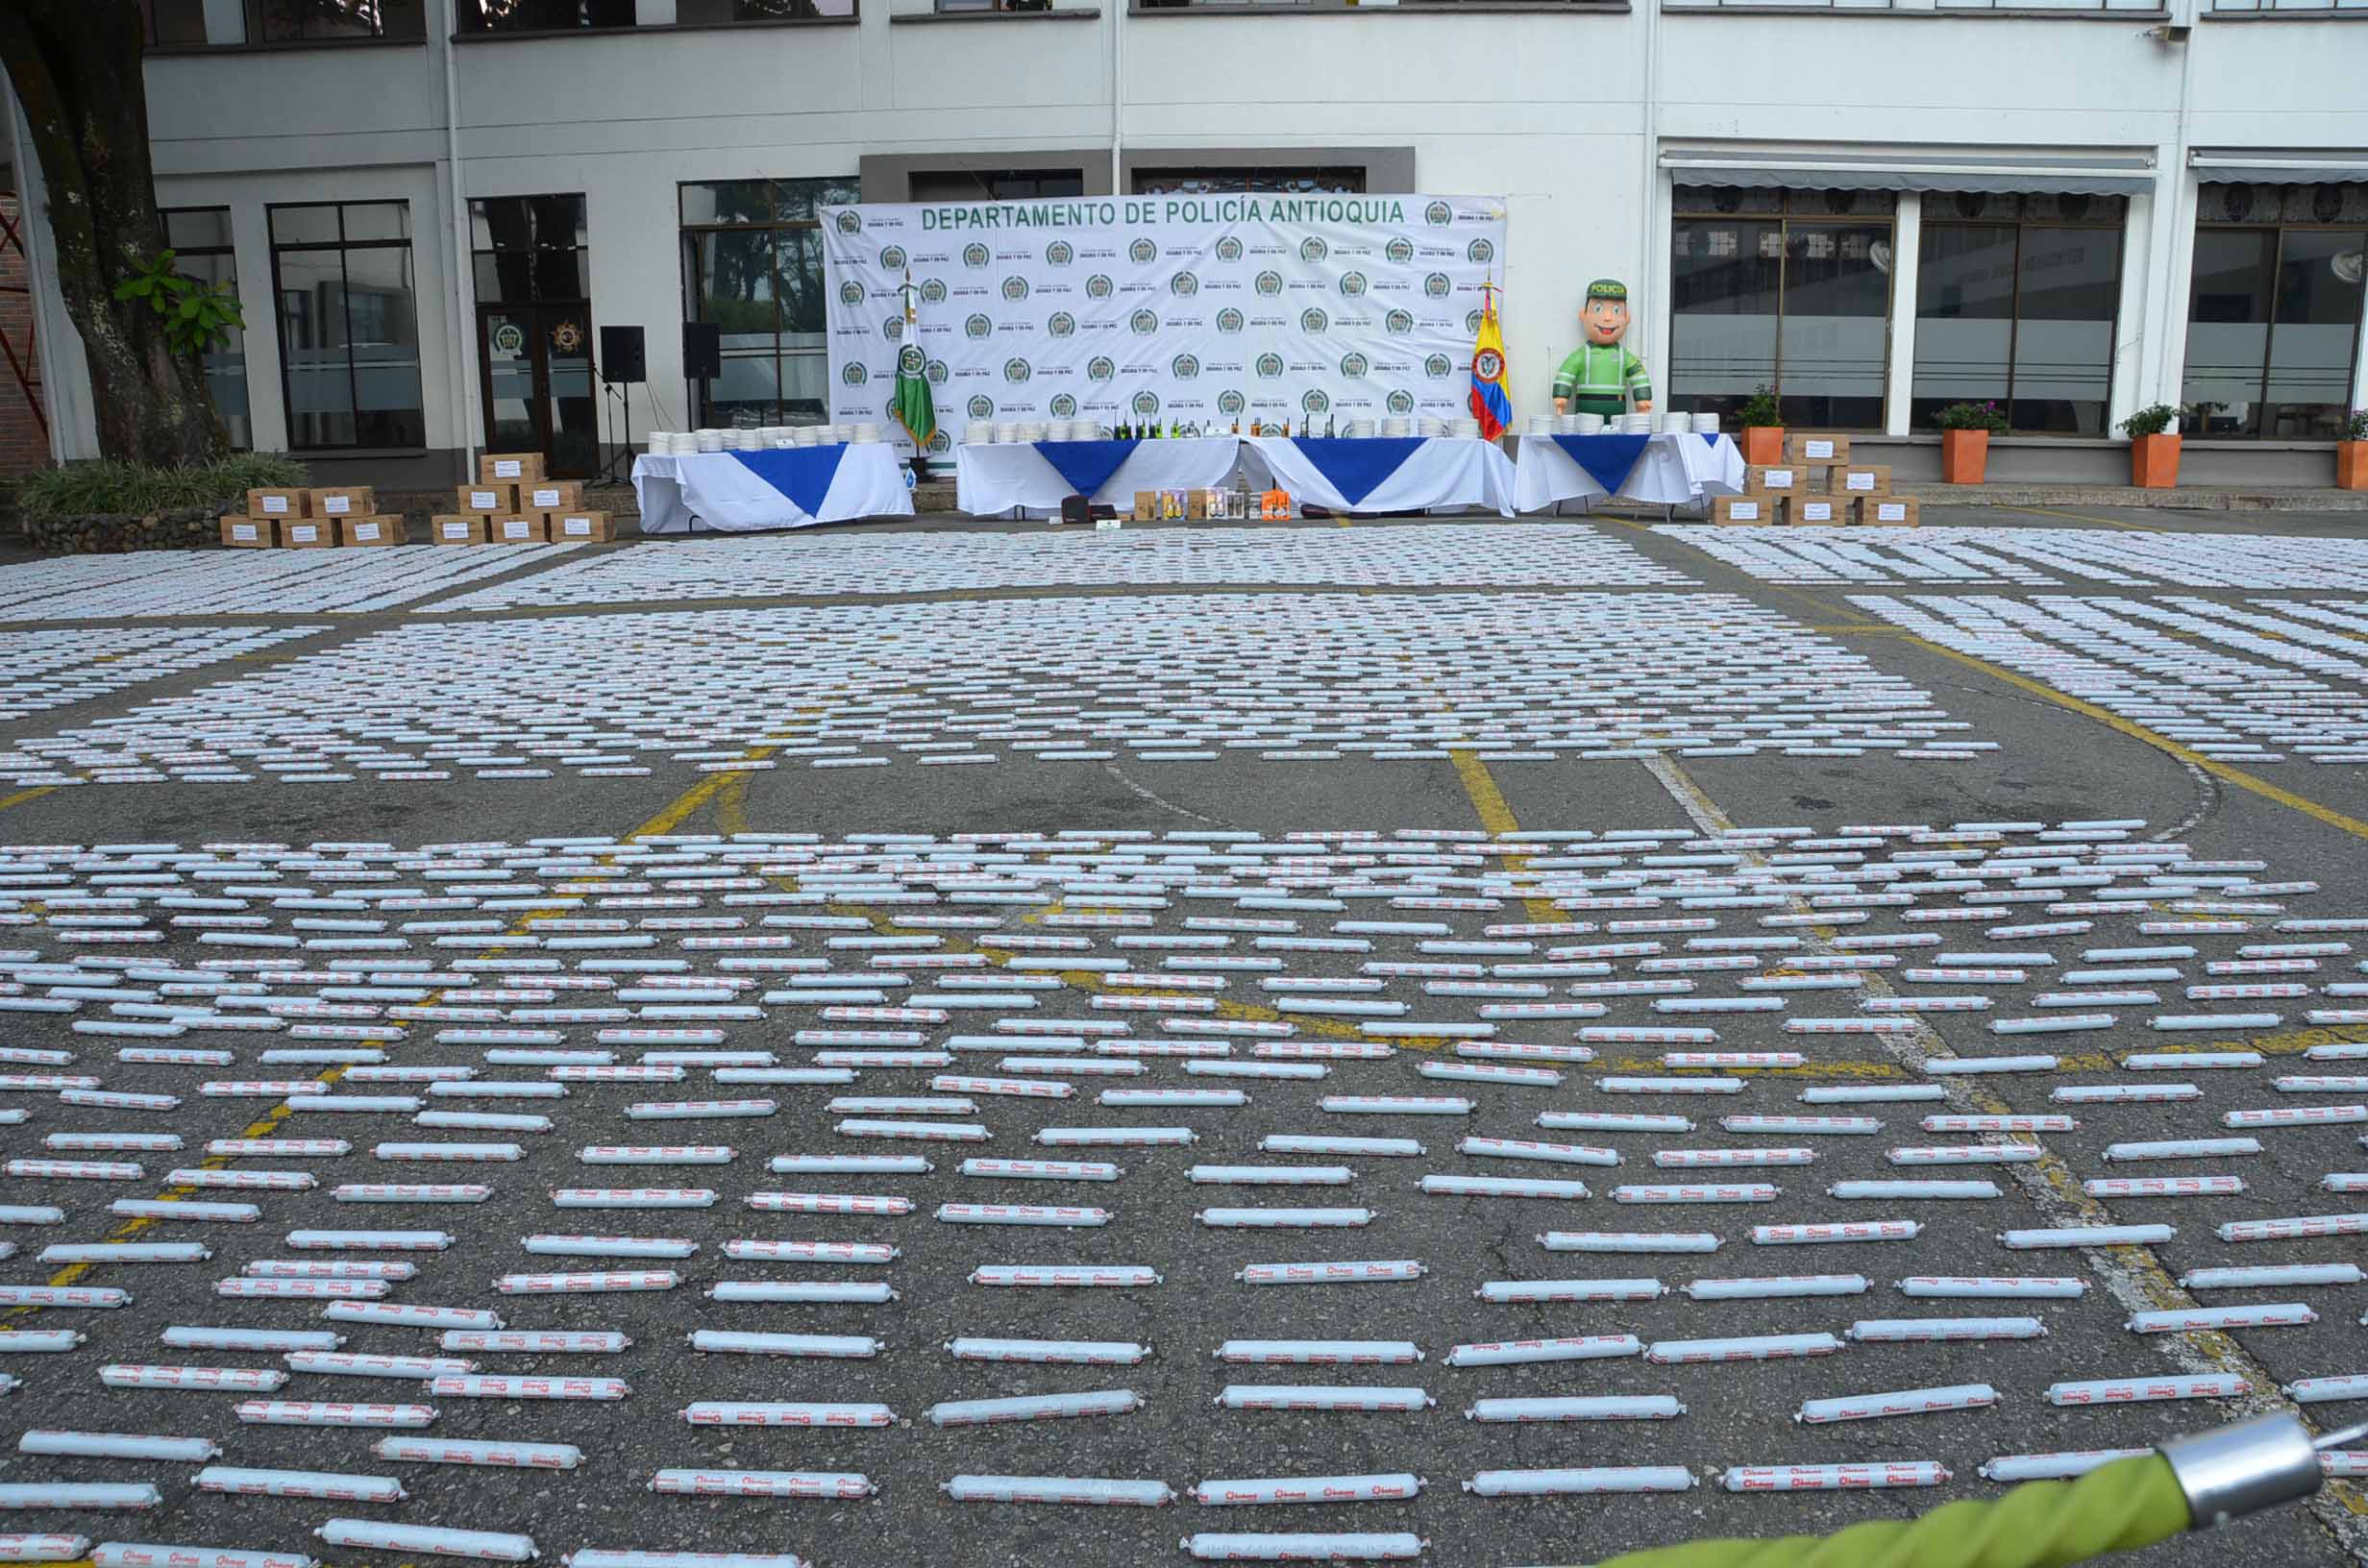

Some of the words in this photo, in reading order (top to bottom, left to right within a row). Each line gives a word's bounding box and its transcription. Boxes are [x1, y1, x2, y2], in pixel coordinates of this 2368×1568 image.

[923, 203, 1116, 230] DEPARTAMENTO
[1125, 202, 1156, 224] DE
[1166, 195, 1263, 223] POLICÍA
[1270, 200, 1405, 224] ANTIOQUIA
